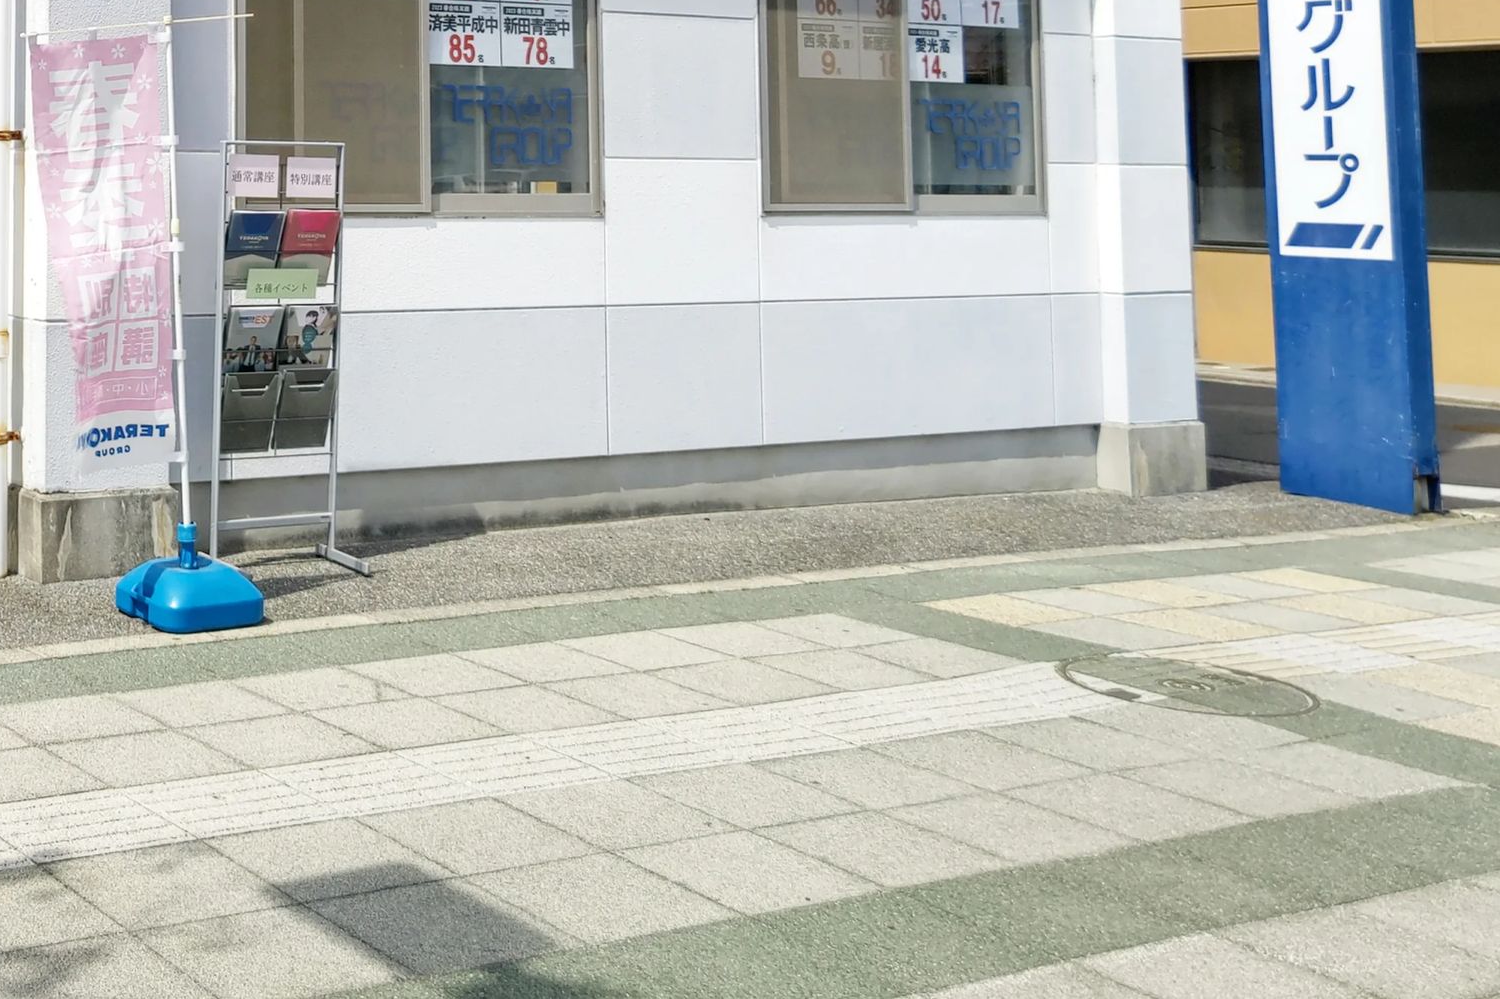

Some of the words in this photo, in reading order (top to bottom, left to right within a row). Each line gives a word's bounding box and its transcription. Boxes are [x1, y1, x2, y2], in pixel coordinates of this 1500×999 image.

[982, 0, 1000, 24] 17
[429, 14, 498, 34] 済美平成中
[503, 17, 570, 36] 新田青雲中
[449, 34, 475, 63] 85
[522, 37, 549, 65] 78
[915, 37, 950, 53] 愛光高
[821, 50, 836, 75] 9
[922, 55, 941, 79] 14
[231, 169, 276, 184] 通常講座
[290, 172, 333, 187] 特別講座
[255, 282, 308, 295] 各種イベント
